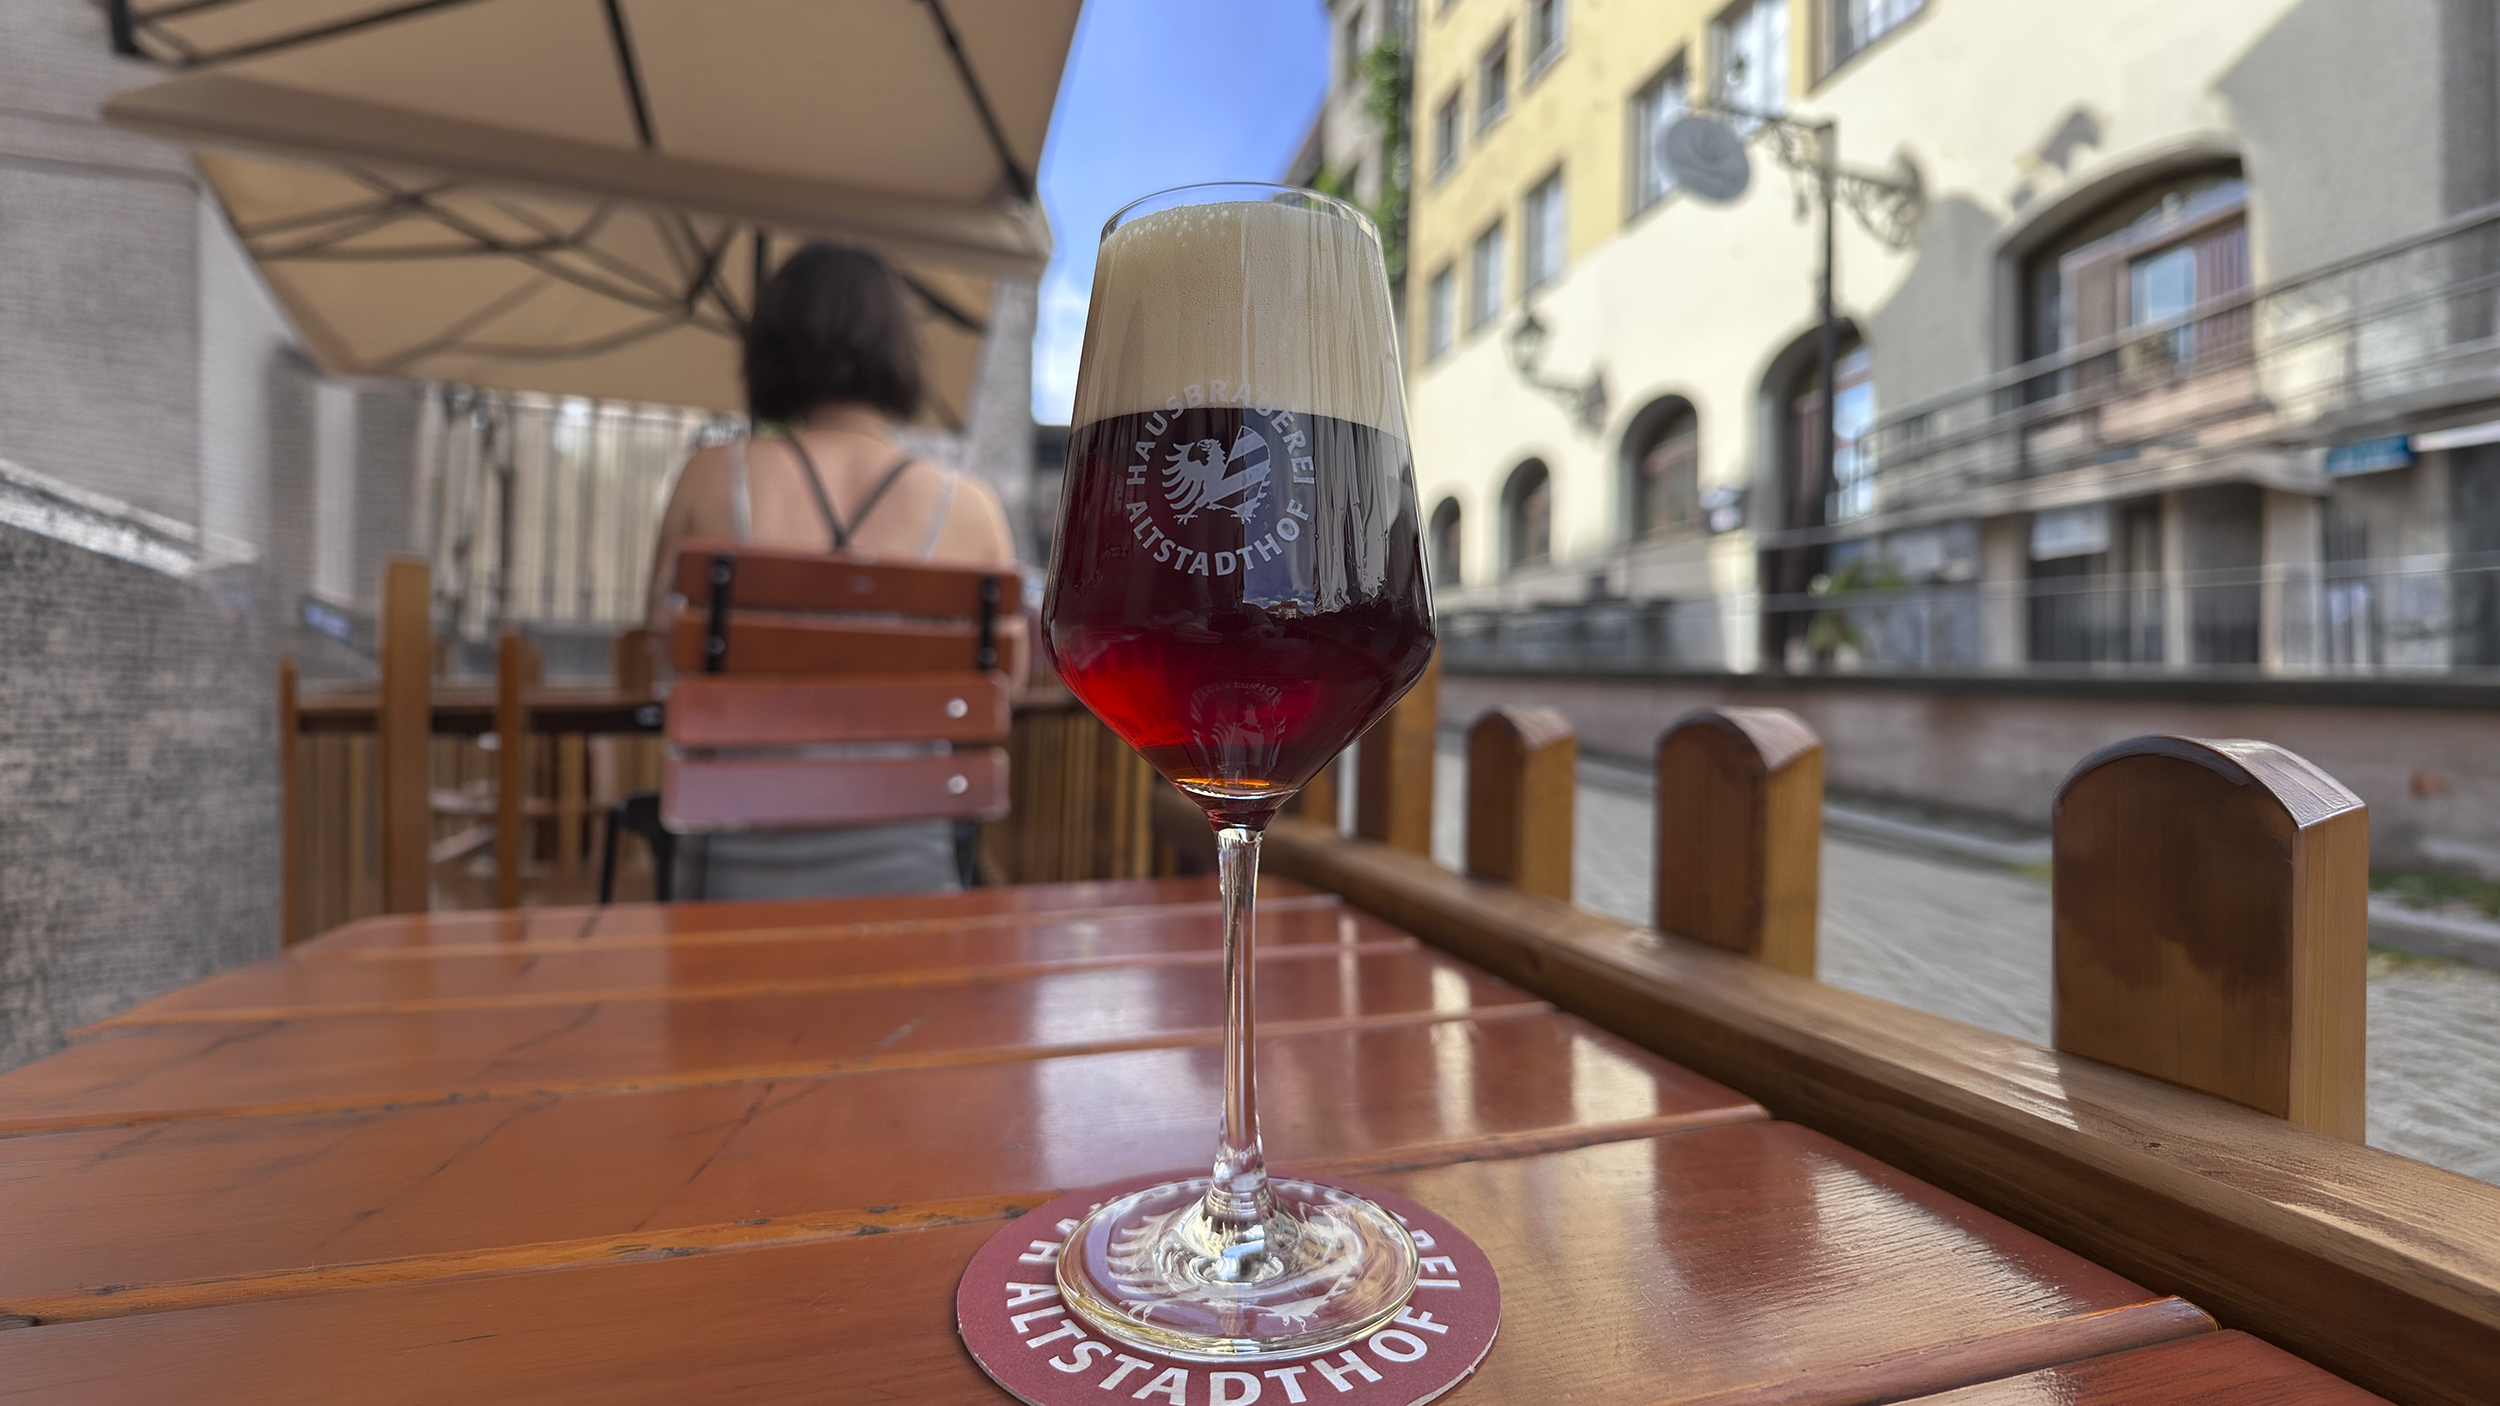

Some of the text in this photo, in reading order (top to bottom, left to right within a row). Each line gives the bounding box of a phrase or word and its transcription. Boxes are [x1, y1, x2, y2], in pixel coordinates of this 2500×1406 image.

[1127, 380, 1315, 485] HAUSBRAUEREI
[1126, 499, 1309, 577] ALTSTADTHOF
[1006, 1281, 1449, 1406] ALTSTADTHOF
